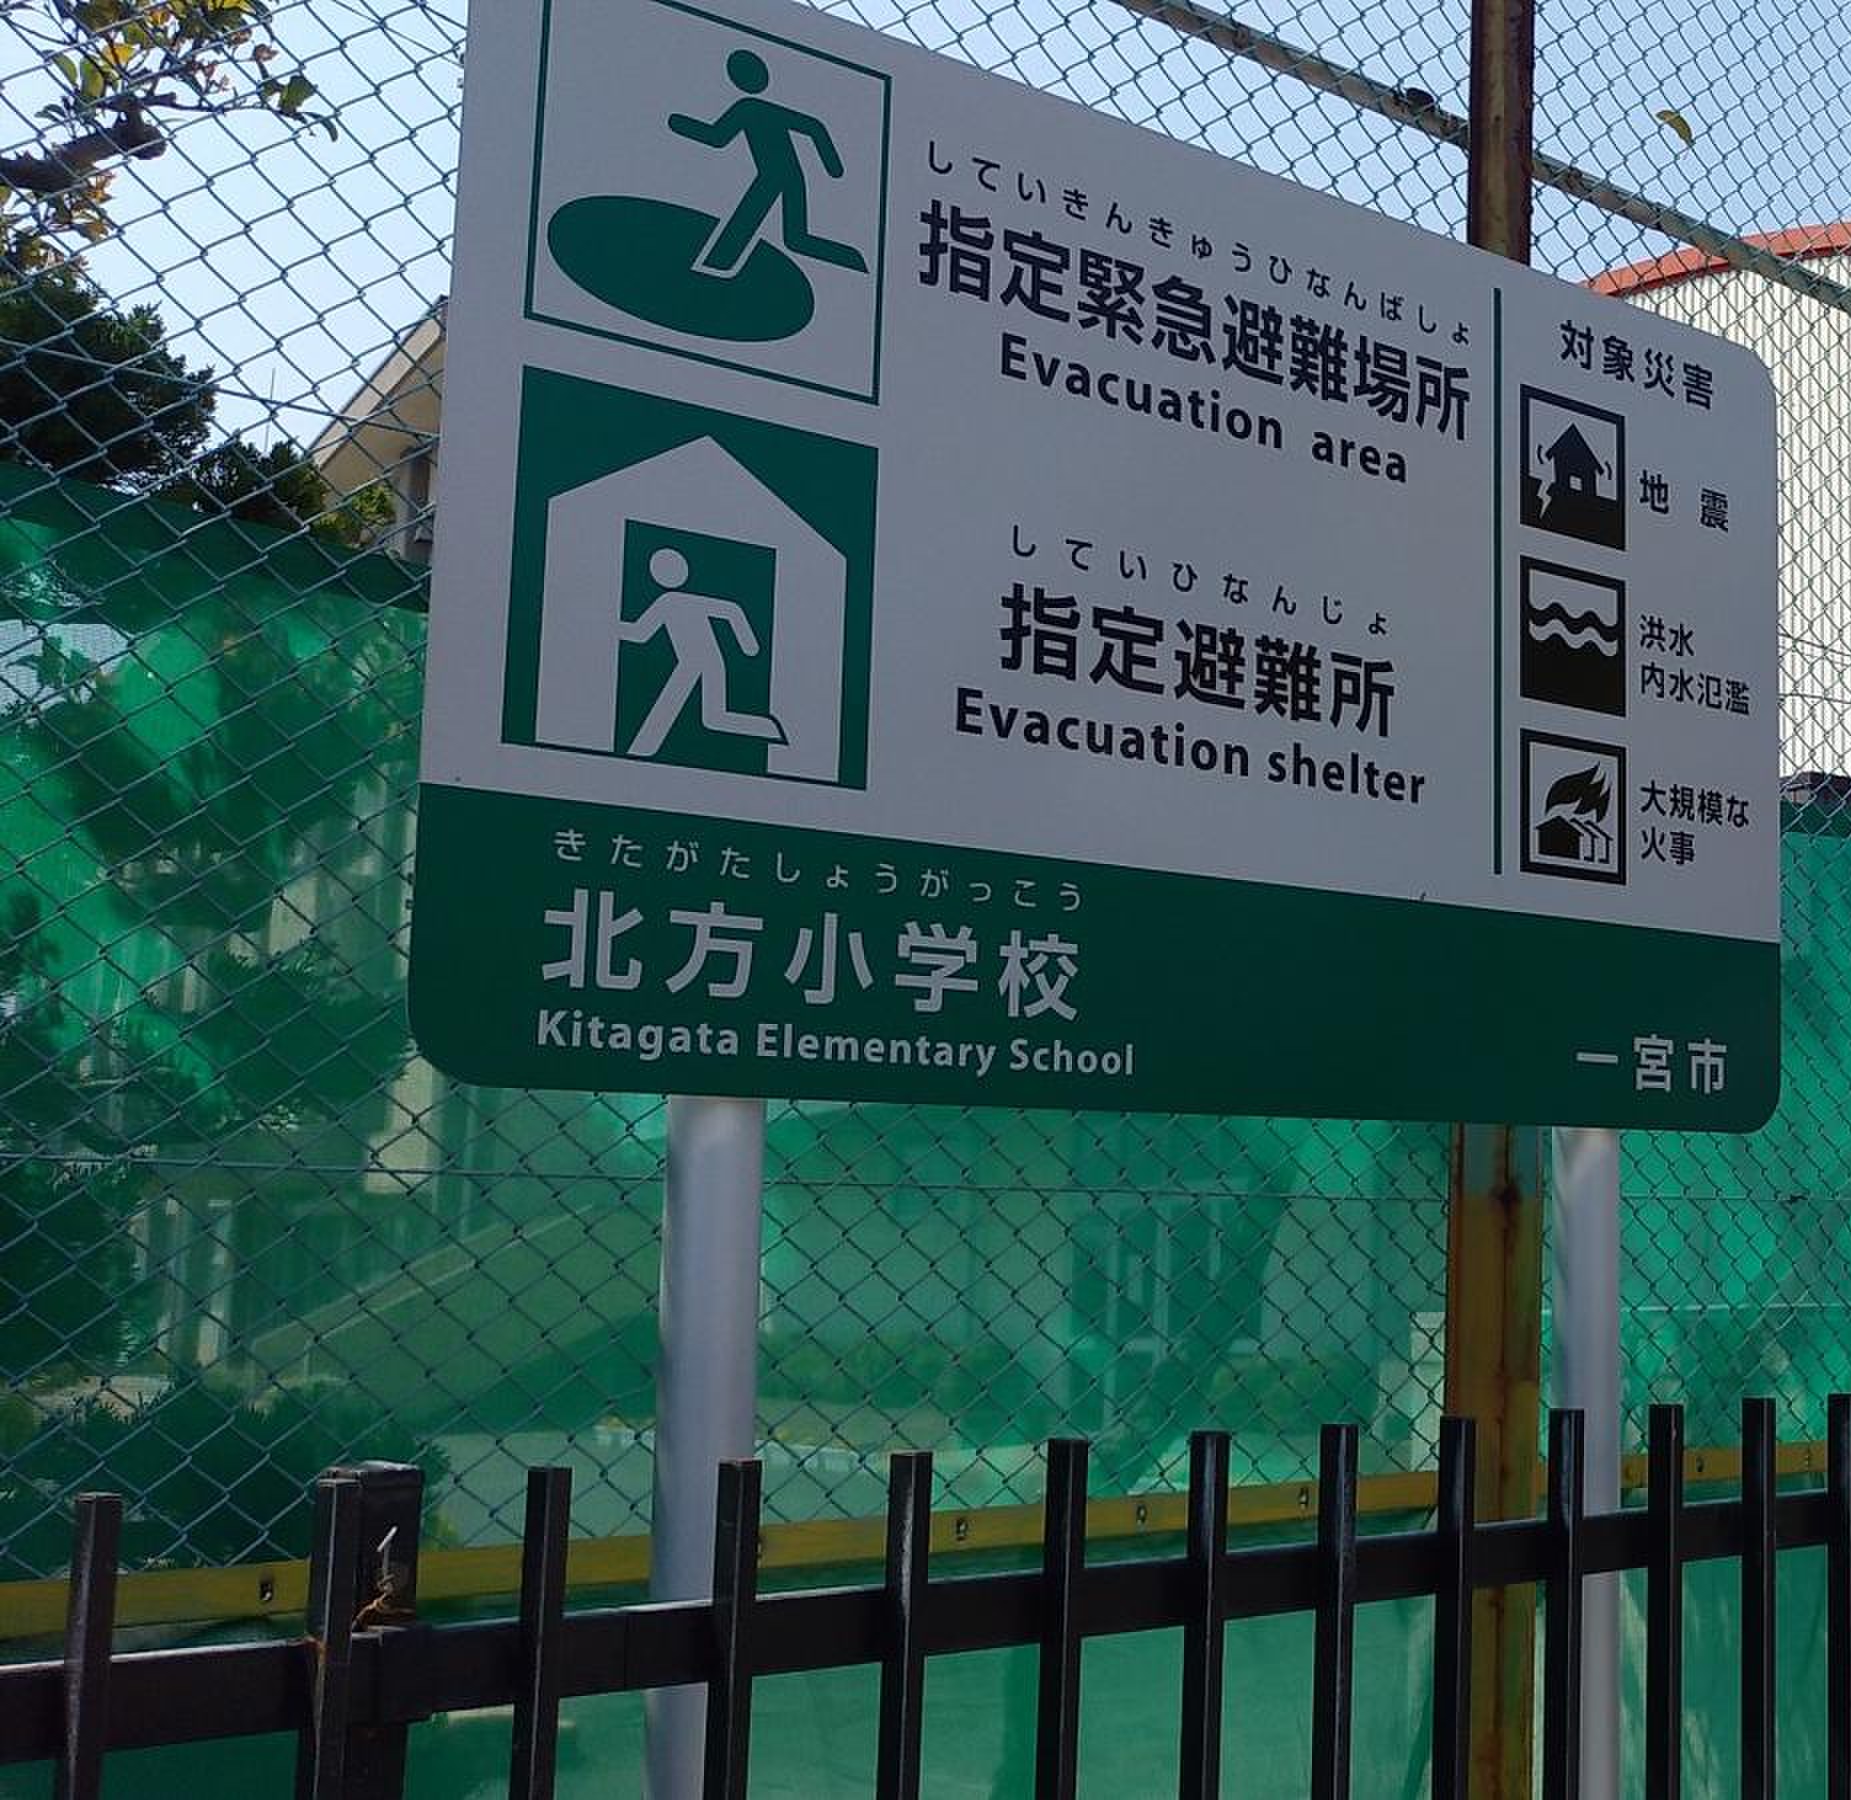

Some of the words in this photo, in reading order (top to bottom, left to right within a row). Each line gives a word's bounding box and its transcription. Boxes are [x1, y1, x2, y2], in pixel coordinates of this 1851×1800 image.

[926, 139, 1472, 346] していきんきゅうひなんばしょ
[918, 199, 1471, 441] 指定緊急避難場所
[1000, 334, 1284, 449] Evacuation
[1311, 430, 1407, 483] area
[1560, 319, 1714, 411] 対象災害
[1639, 469, 1729, 533] 地震
[1010, 525, 1391, 638] していひなんじょ
[1000, 582, 1396, 738] 指定避難所
[1639, 613, 1695, 657] 洪水
[1641, 661, 1751, 716] 内水氾濫
[955, 686, 1251, 777] Evacuation
[1266, 742, 1426, 805] shelter
[1640, 779, 1750, 829] 大規模な
[1641, 826, 1696, 866] 火事
[552, 828, 1084, 913] きたがたしょうがっこう
[541, 888, 1080, 1022] 北方小学校
[536, 1008, 740, 1061] Kitagata
[755, 1022, 997, 1078] Elementary
[1008, 1038, 1135, 1077] School
[1575, 1033, 1728, 1094] 一宮市
